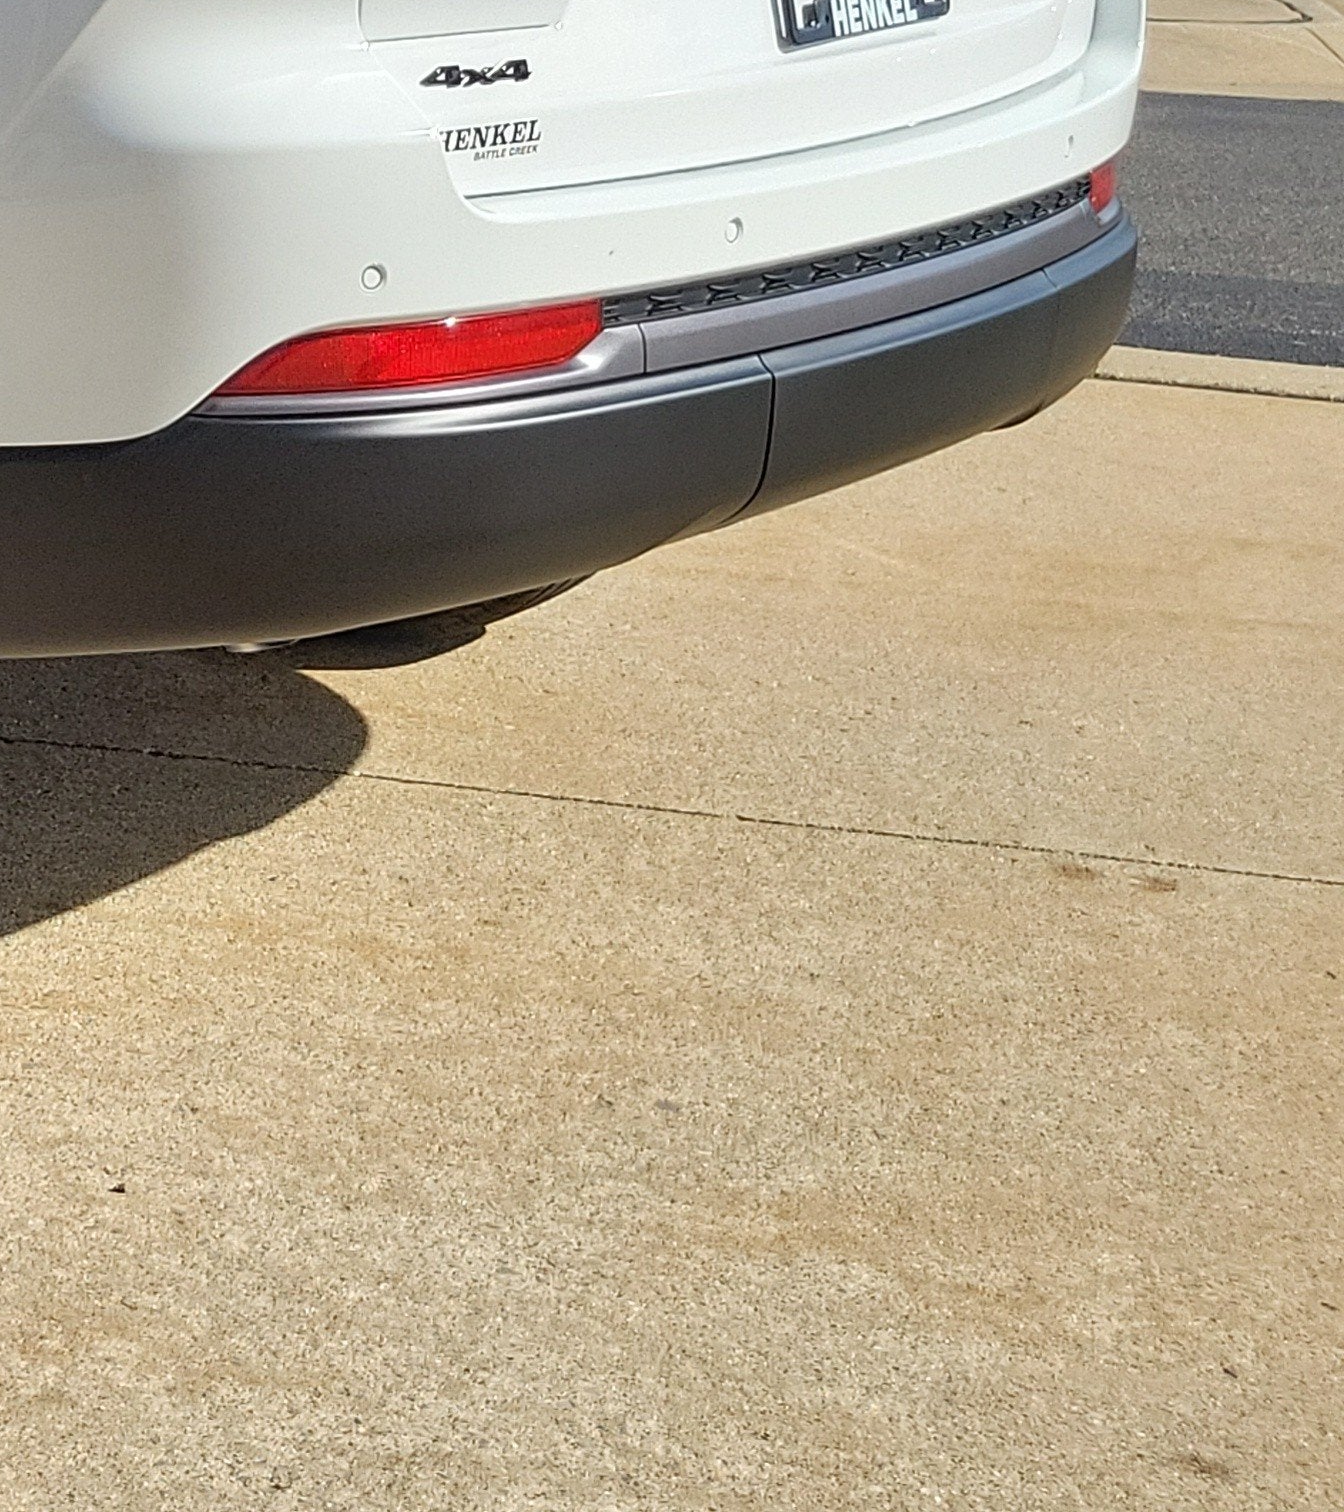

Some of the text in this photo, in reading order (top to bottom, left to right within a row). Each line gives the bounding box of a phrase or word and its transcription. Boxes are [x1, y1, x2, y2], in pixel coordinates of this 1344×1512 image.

[419, 58, 532, 88] 4x4
[473, 144, 539, 161] BATTLE CREEK
